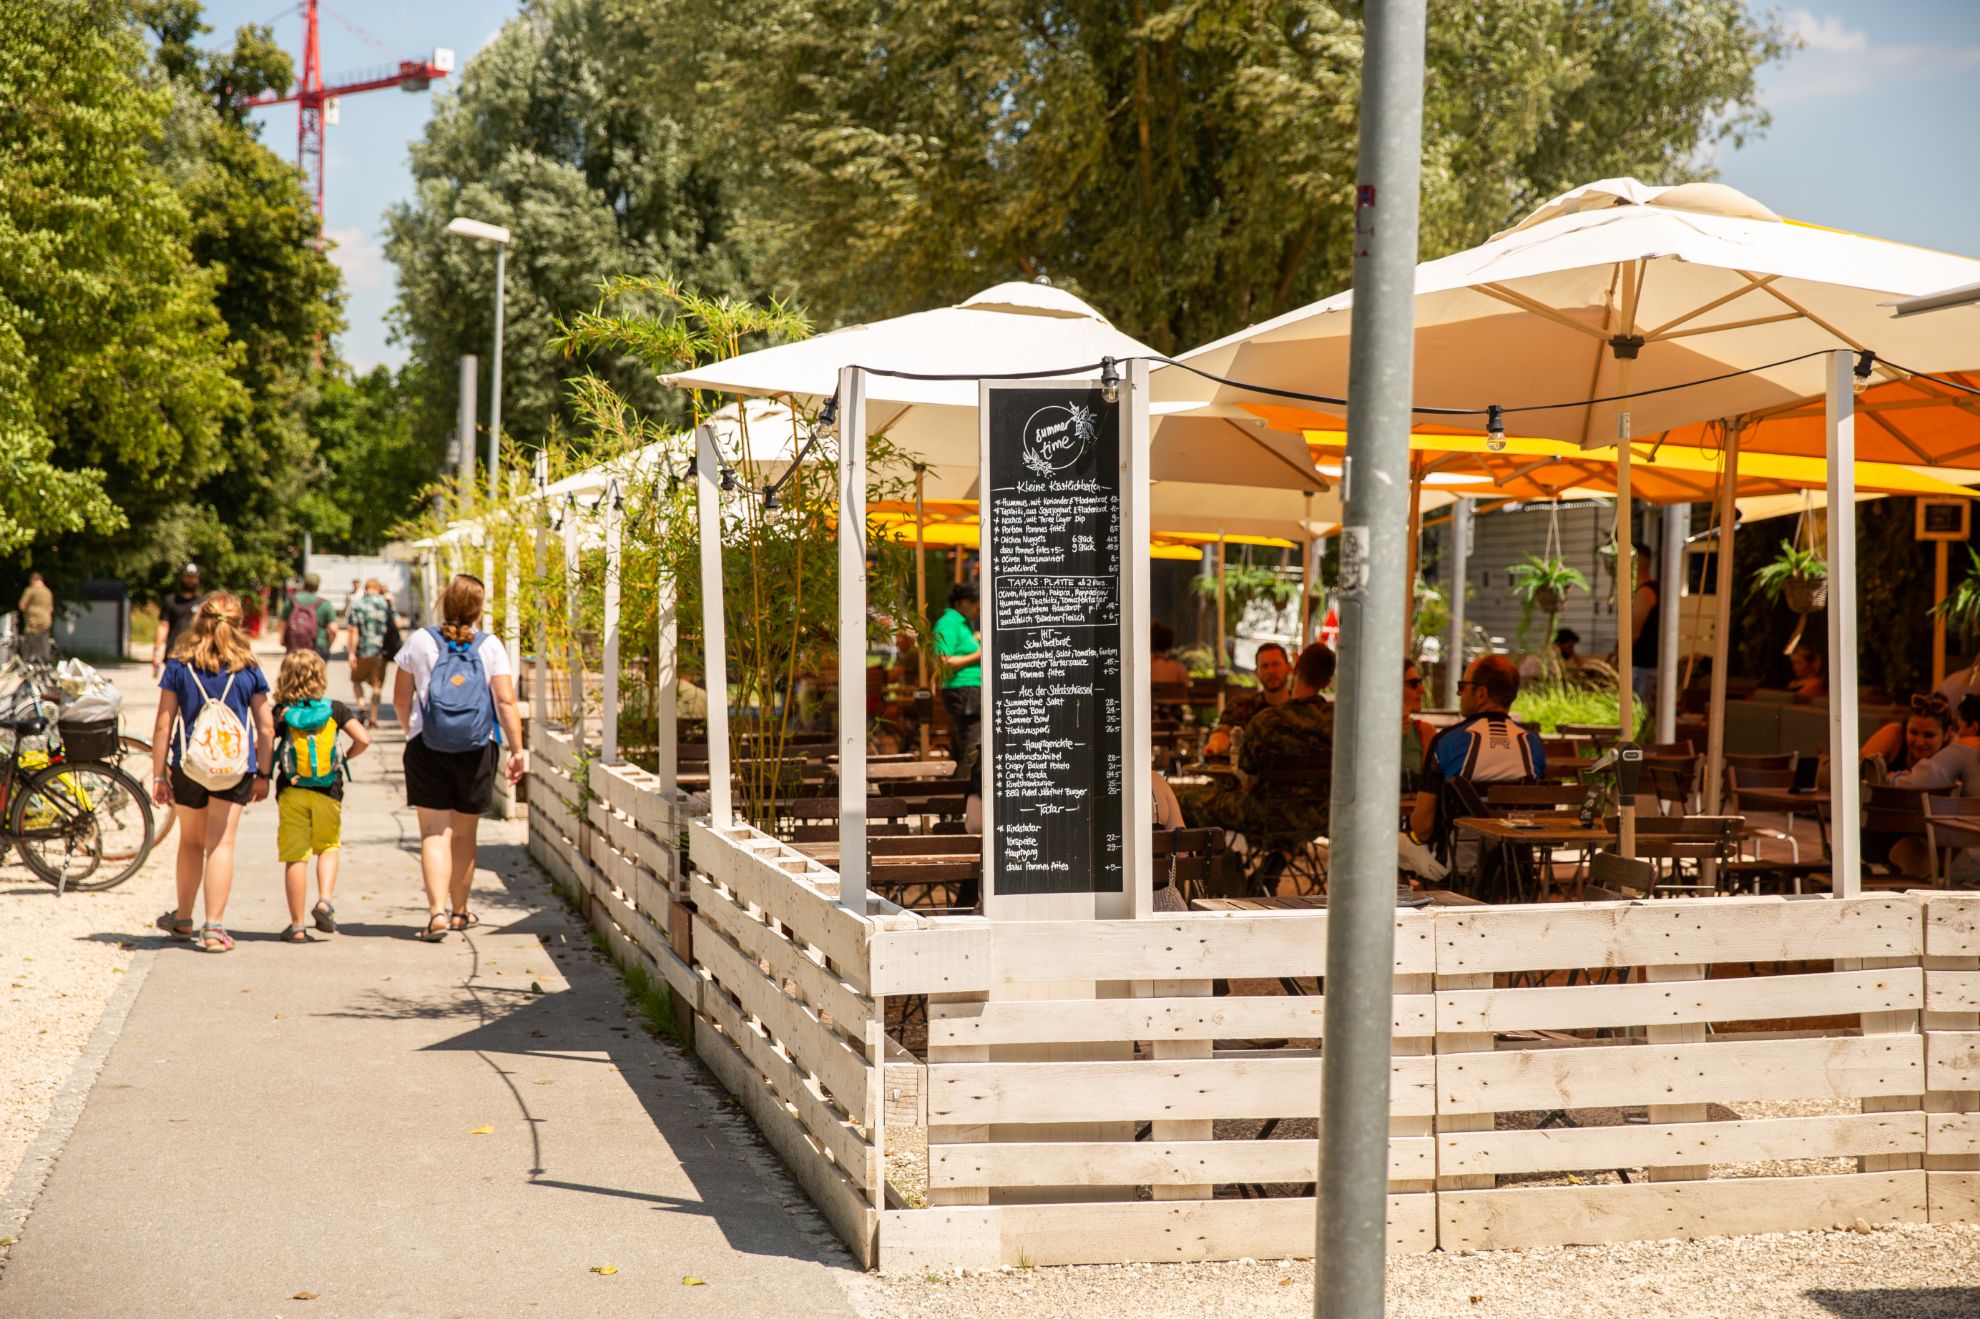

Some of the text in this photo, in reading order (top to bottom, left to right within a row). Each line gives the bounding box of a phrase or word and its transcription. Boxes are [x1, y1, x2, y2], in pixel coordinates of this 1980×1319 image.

[1040, 436, 1075, 460] time
[1017, 481, 1046, 494] Kleine
[1025, 524, 1048, 534] Pommes
[1022, 534, 1047, 546] Nuggets
[1071, 543, 1077, 553] 9
[1007, 578, 1039, 587] TAPAS
[1044, 577, 1075, 586] PLATTE
[1018, 684, 1034, 697] Aus
[1035, 684, 1047, 697] der
[1003, 697, 1044, 707] Summertime
[1005, 707, 1028, 716] Garden
[1028, 706, 1046, 715] Bowl
[1005, 716, 1033, 725] Summer
[1032, 714, 1050, 724] Bowl
[1004, 762, 1026, 773] Crispy
[1026, 761, 1048, 770] Baked
[1049, 762, 1071, 770] Potato
[1005, 771, 1024, 780] Carne
[1025, 770, 1048, 780] Asada
[1004, 789, 1020, 798] BBQ
[1063, 787, 1089, 799] Burger
[1034, 803, 1066, 817] Tatar
[1006, 861, 1023, 872] dazu
[1025, 861, 1050, 871] Pommes
